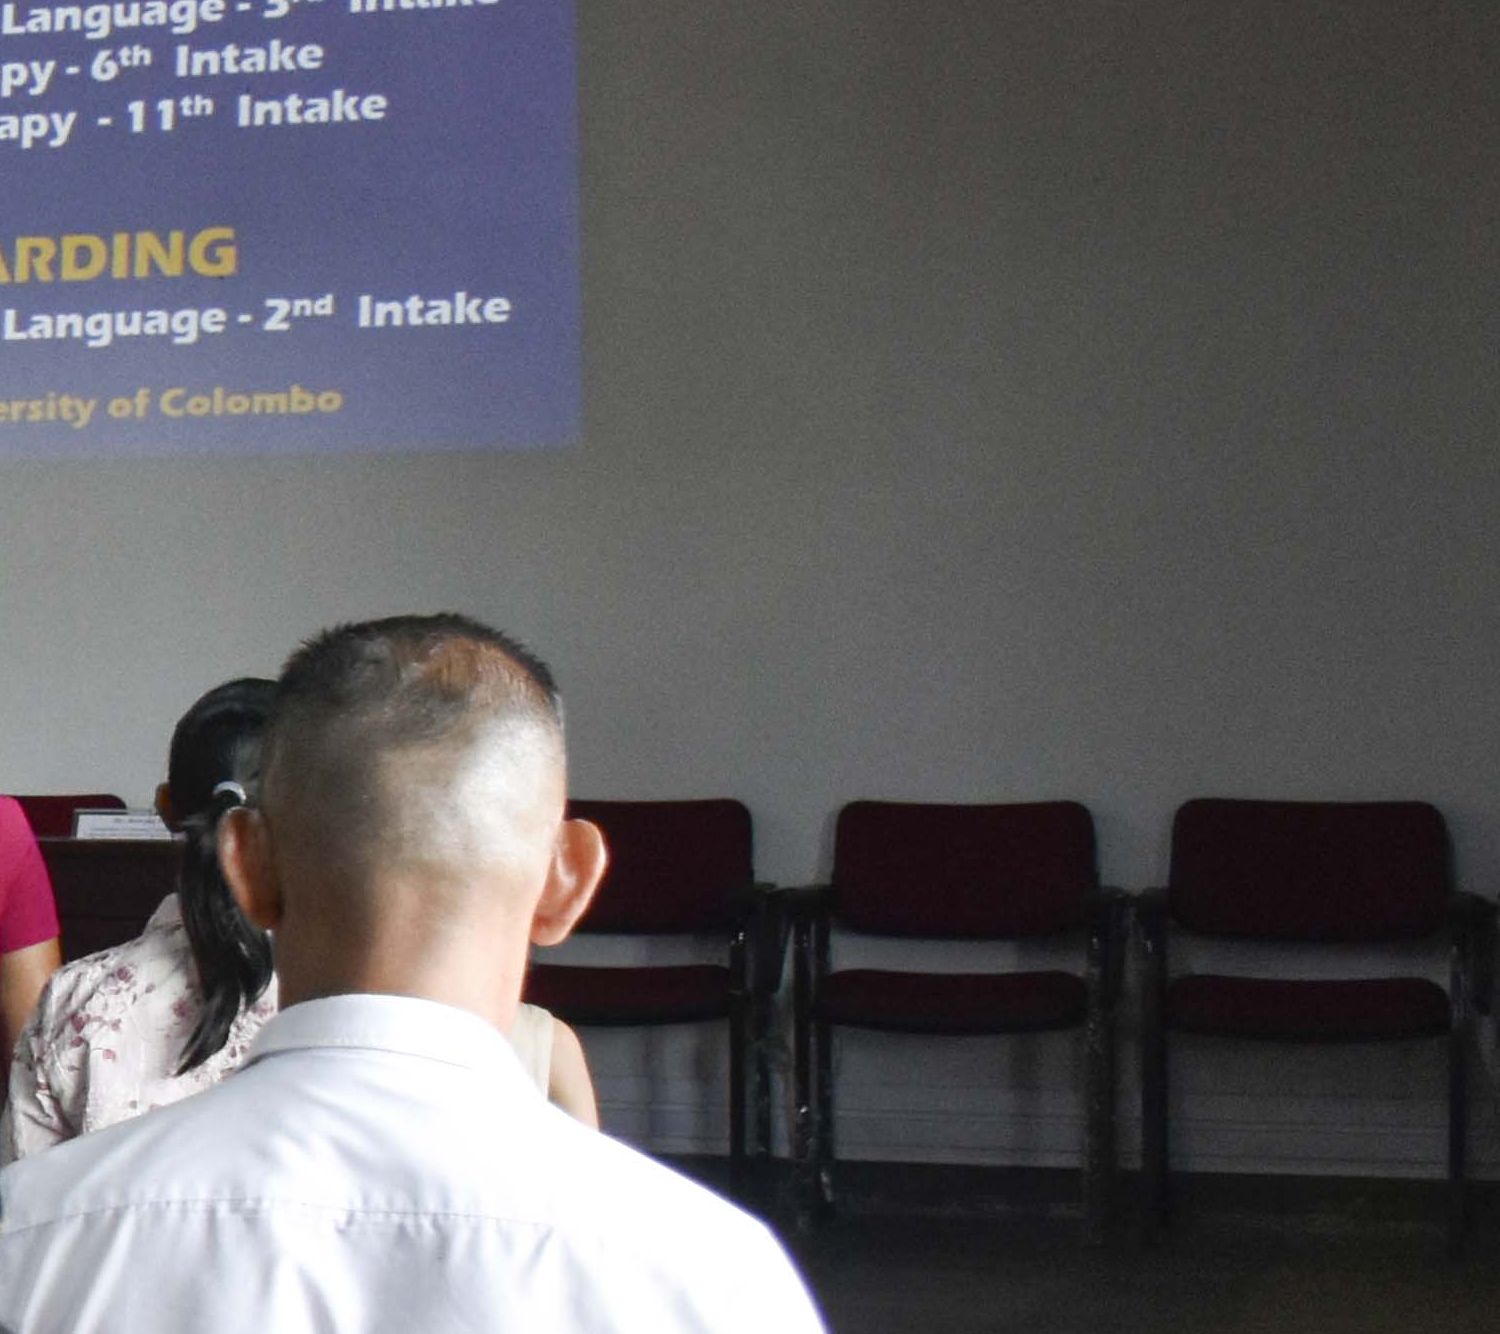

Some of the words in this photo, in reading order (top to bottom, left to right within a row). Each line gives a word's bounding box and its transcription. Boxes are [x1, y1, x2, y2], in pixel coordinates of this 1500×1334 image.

[91, 45, 151, 81] 6th
[177, 39, 324, 76] Intake
[128, 95, 214, 132] 11th
[239, 89, 388, 127] Intake
[4, 308, 227, 347] Language
[264, 294, 334, 330] 2nd
[359, 291, 511, 327] Intake
[108, 387, 149, 417] of
[160, 384, 342, 416] Colombo
